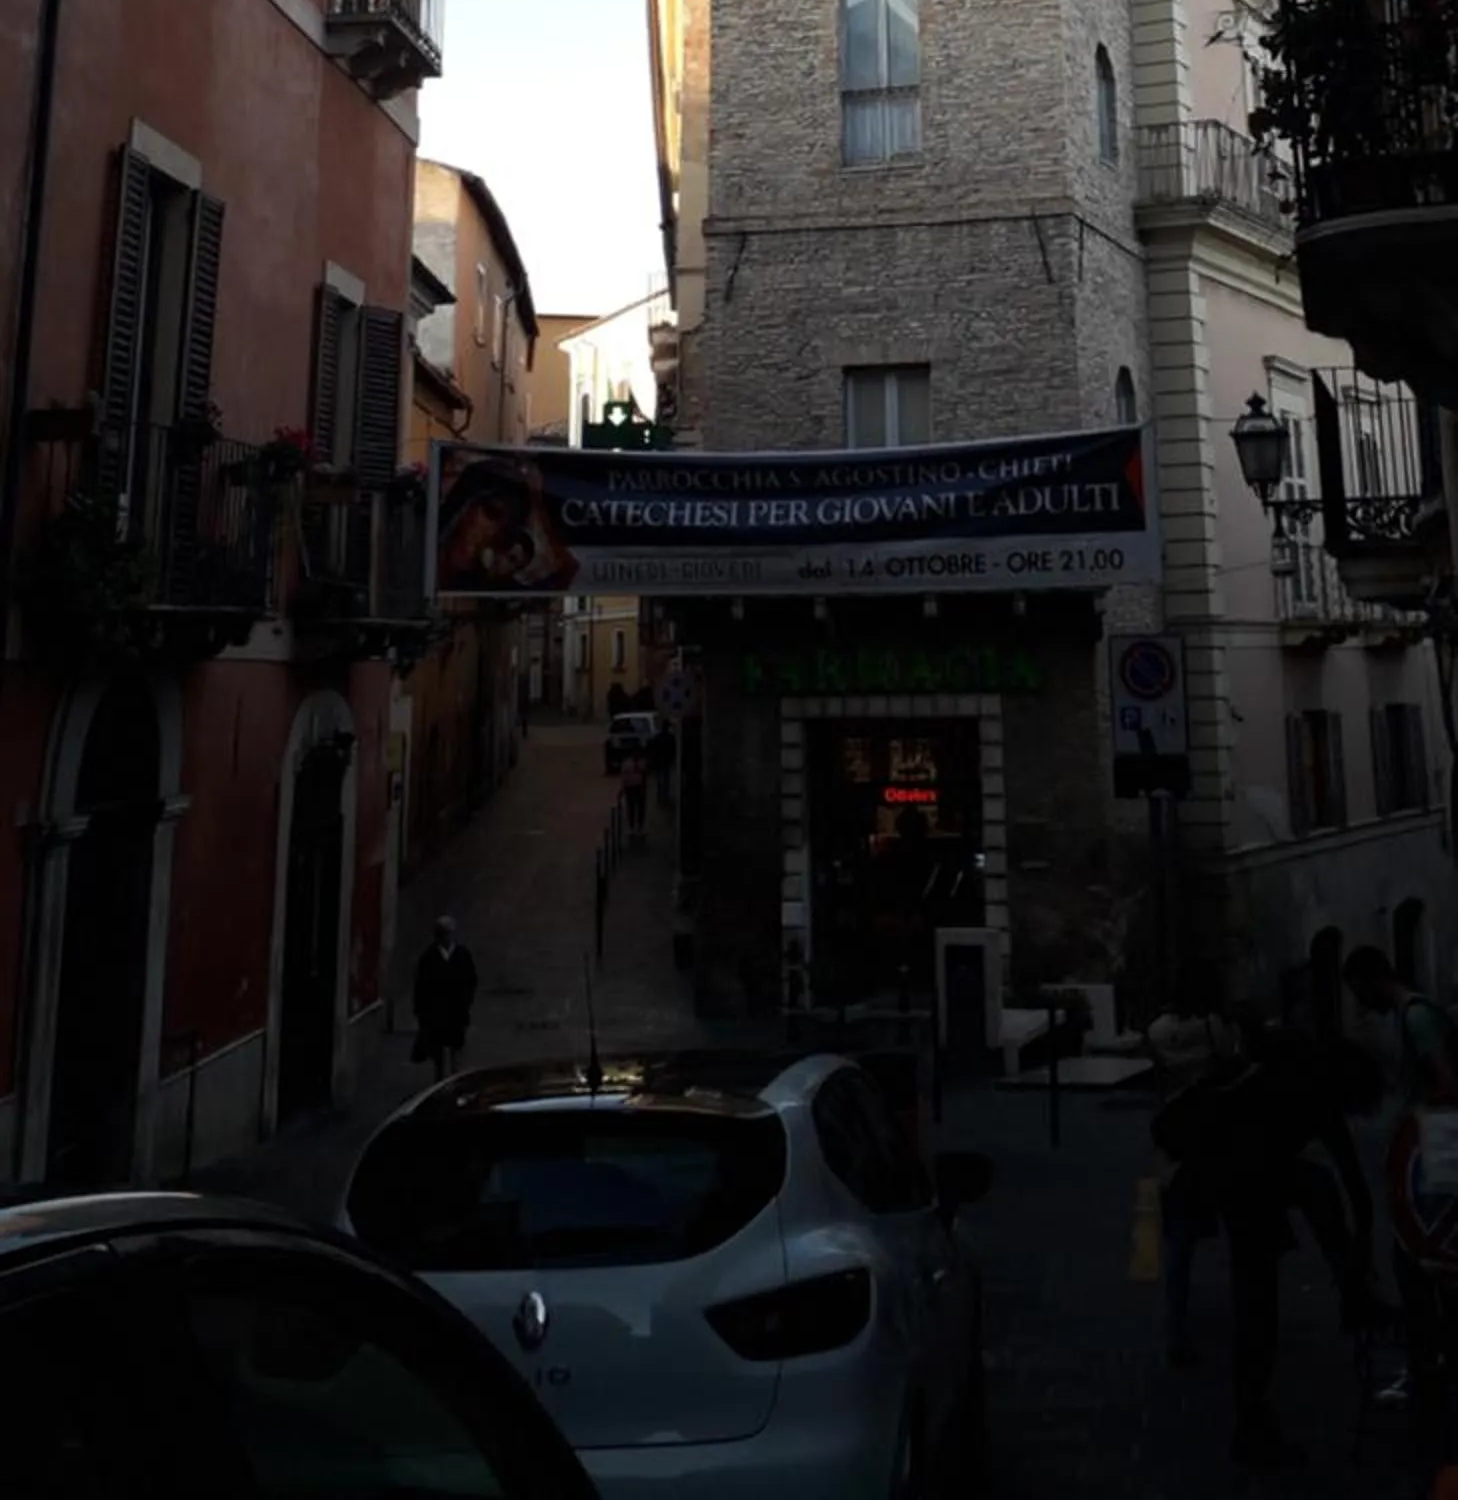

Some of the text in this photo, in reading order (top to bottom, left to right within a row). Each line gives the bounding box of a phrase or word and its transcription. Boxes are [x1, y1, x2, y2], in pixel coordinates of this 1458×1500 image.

[607, 468, 782, 491] PARROCCHIA
[813, 460, 962, 488] AGOSTINO
[977, 452, 1073, 481] CHIETI
[560, 481, 1121, 528] CATECHESI PER GIOVANI E ADULTI
[797, 555, 832, 579] dal
[846, 557, 874, 578] 14
[885, 553, 987, 577] OTTOBRE
[1006, 551, 1053, 574] ORE
[740, 643, 1045, 692] FARMACIA
[536, 1366, 571, 1387] IO
